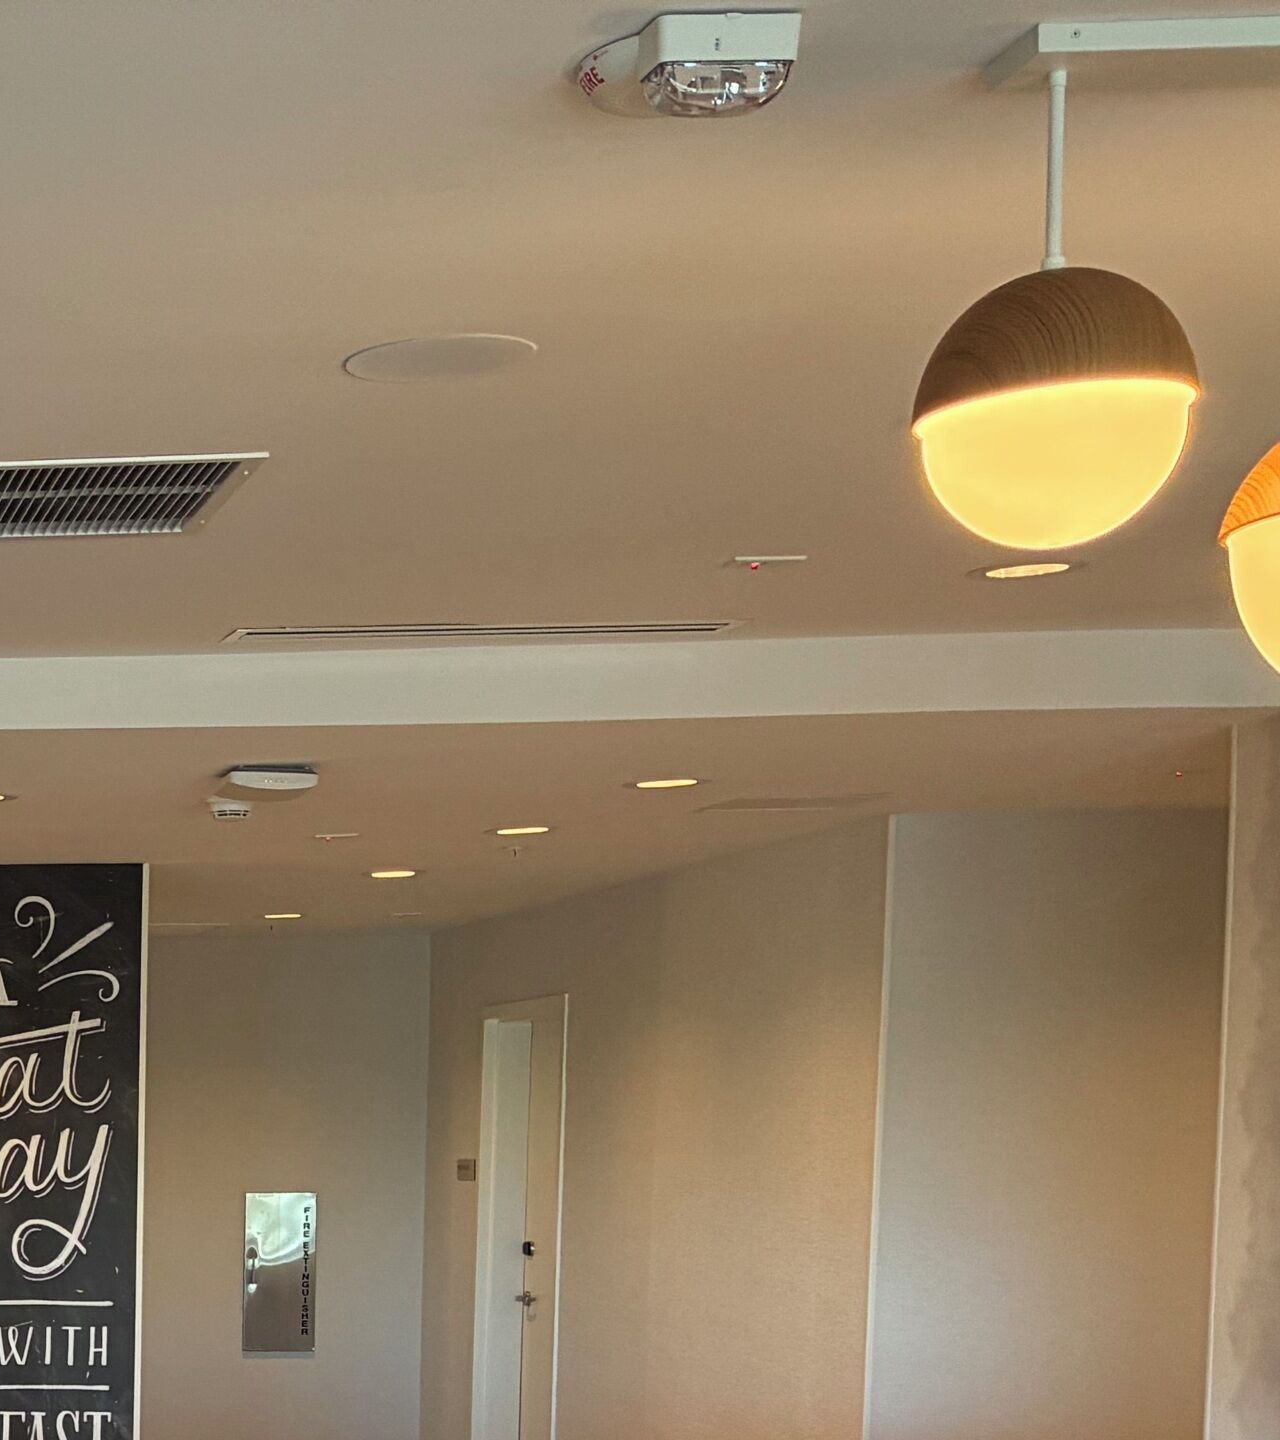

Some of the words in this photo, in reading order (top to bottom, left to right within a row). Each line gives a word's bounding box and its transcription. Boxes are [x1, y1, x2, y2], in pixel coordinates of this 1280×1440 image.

[579, 66, 605, 97] FIRE
[303, 1206, 311, 1238] FIRE
[300, 1241, 310, 1336] EXTINGUISHER
